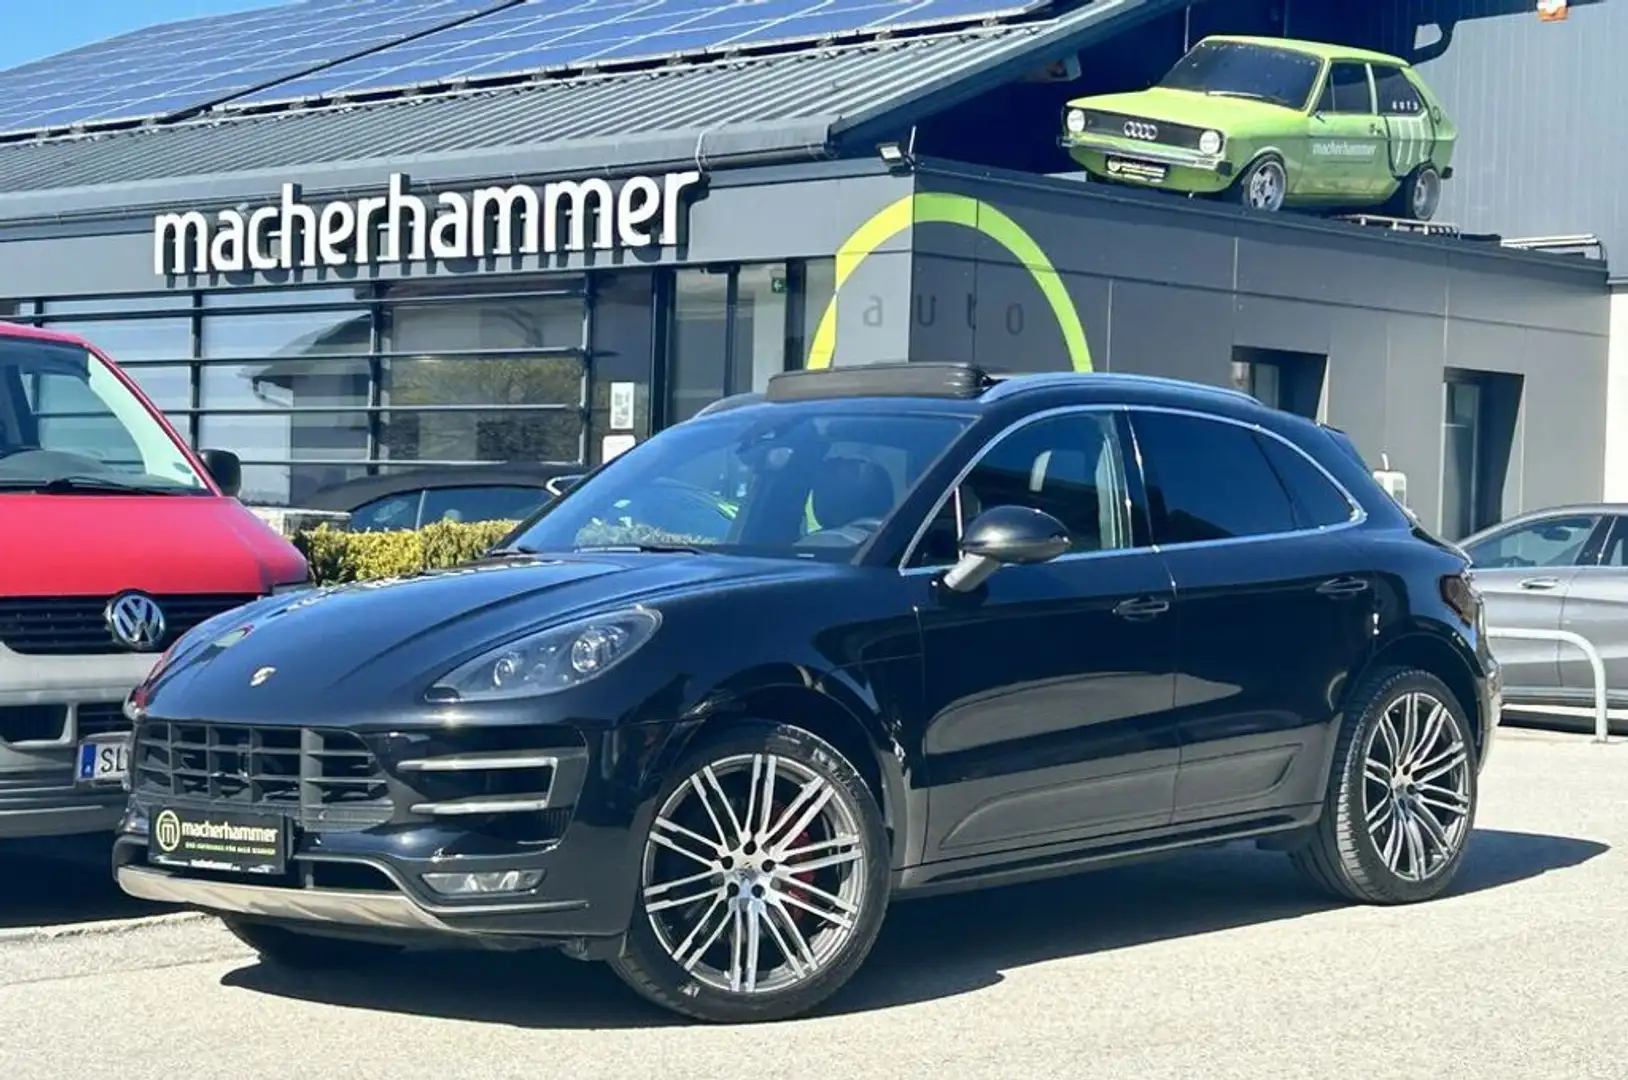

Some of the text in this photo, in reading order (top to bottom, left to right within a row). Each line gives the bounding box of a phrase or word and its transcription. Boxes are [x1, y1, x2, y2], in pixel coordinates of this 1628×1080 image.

[154, 172, 699, 276] macherhammer
[862, 293, 1024, 336] auto
[181, 820, 279, 843] macherhammer
